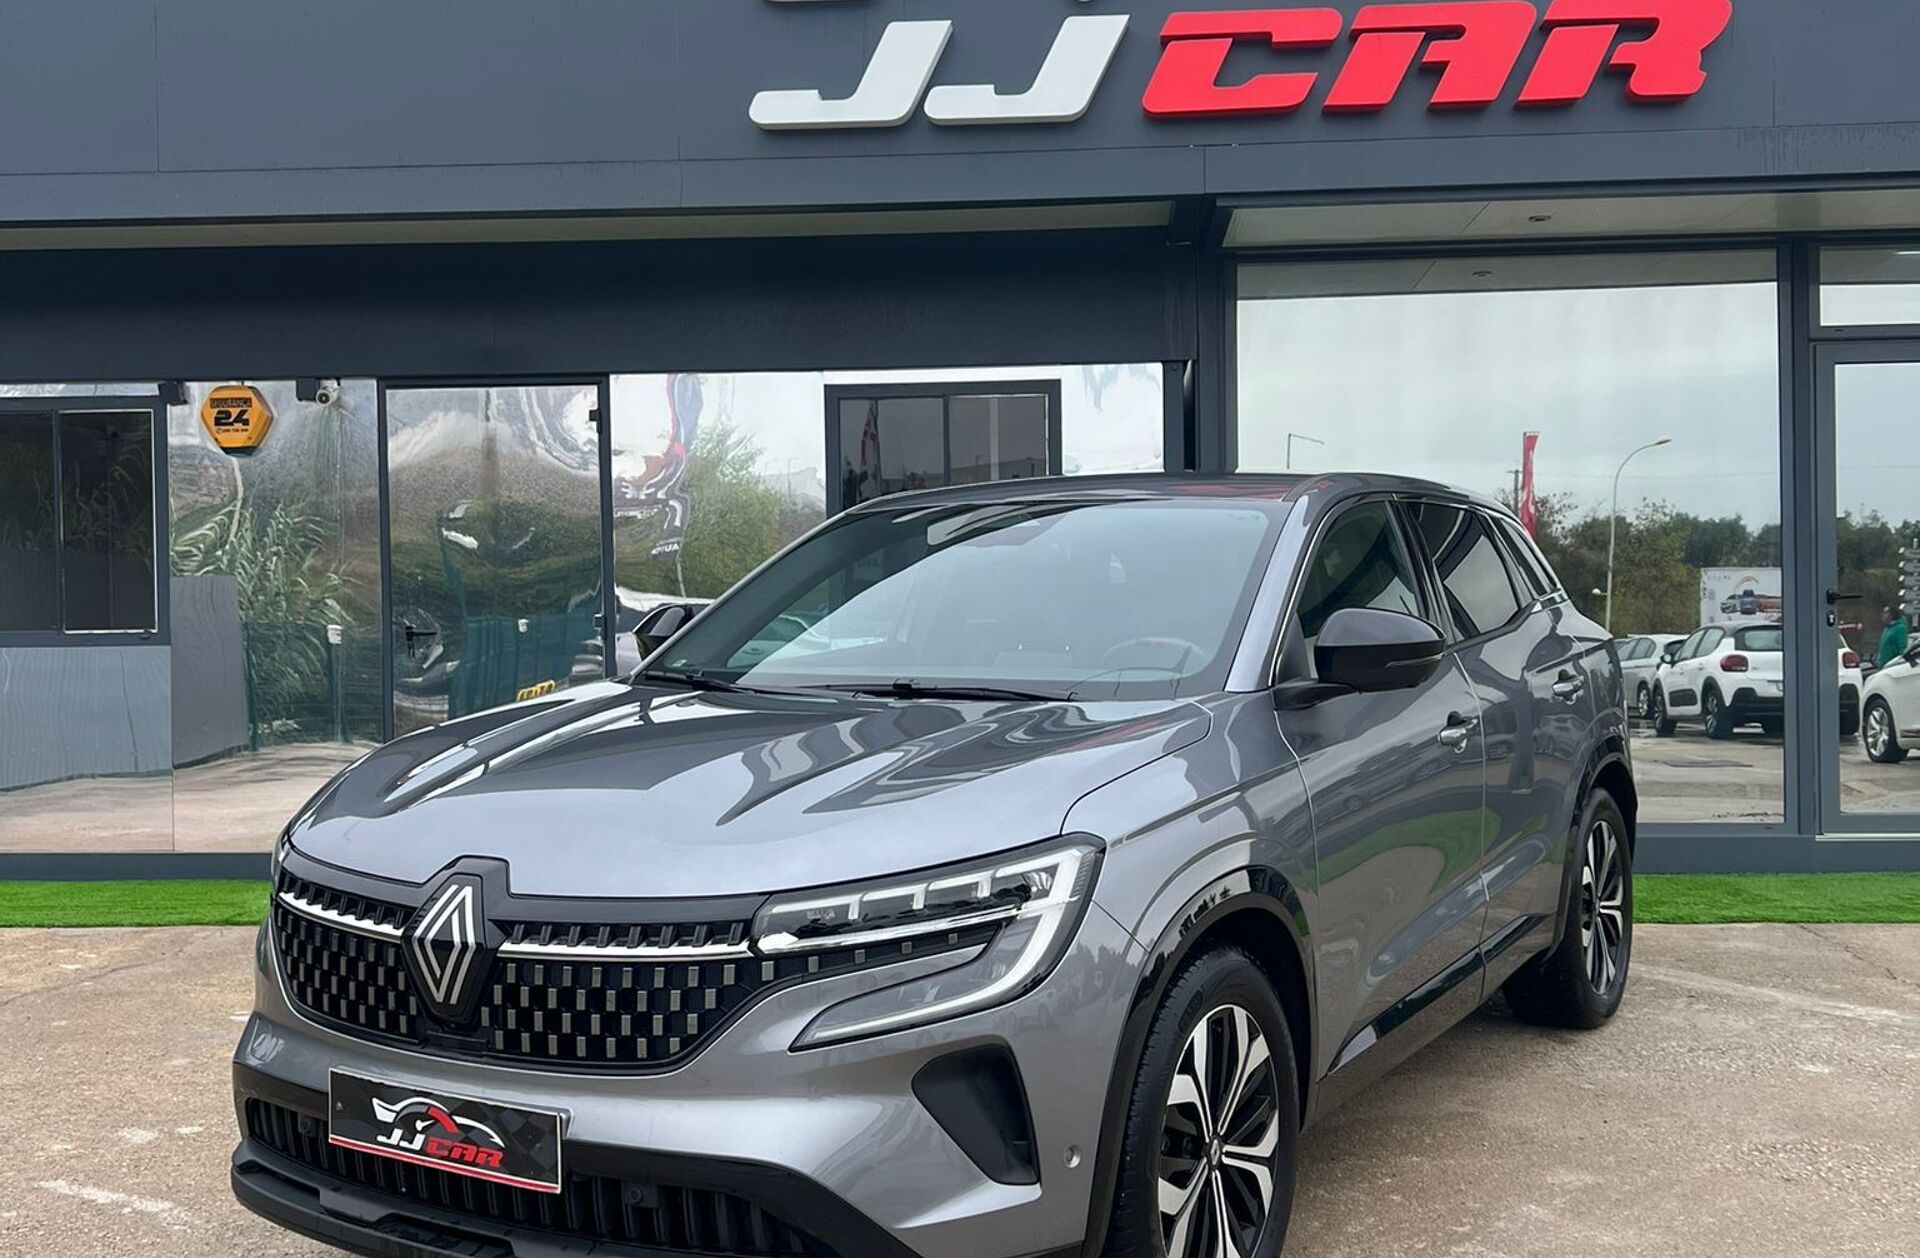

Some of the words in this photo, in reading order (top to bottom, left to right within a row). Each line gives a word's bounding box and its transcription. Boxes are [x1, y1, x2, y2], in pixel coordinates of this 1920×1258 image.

[748, 14, 1131, 130] JJ
[1142, 0, 1733, 118] CAR
[214, 409, 250, 427] 24
[376, 1128, 426, 1151] JJ
[426, 1136, 504, 1168] CAR
